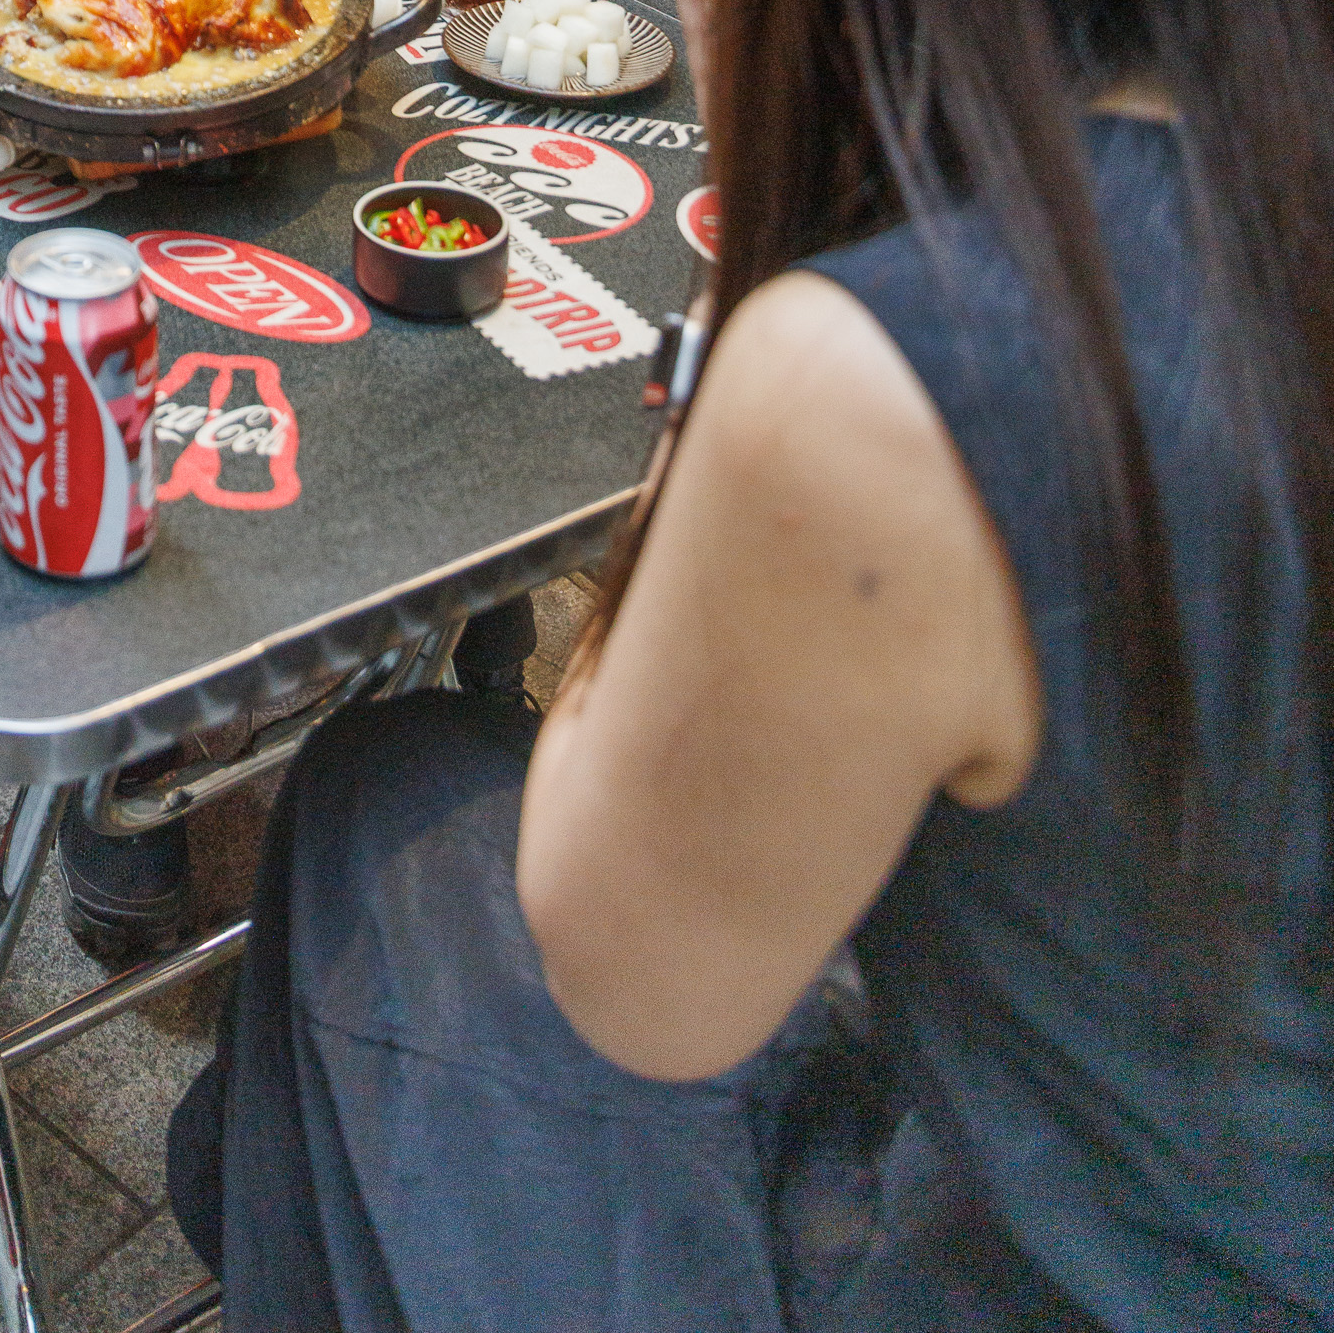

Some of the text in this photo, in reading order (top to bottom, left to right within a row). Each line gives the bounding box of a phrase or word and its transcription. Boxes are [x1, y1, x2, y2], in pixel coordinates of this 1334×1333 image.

[390, 81, 704, 150] COZY NIGHTS
[443, 162, 554, 220] BEACH
[157, 237, 334, 328] OPEN
[53, 374, 70, 509] ORIGINAL TASTE
